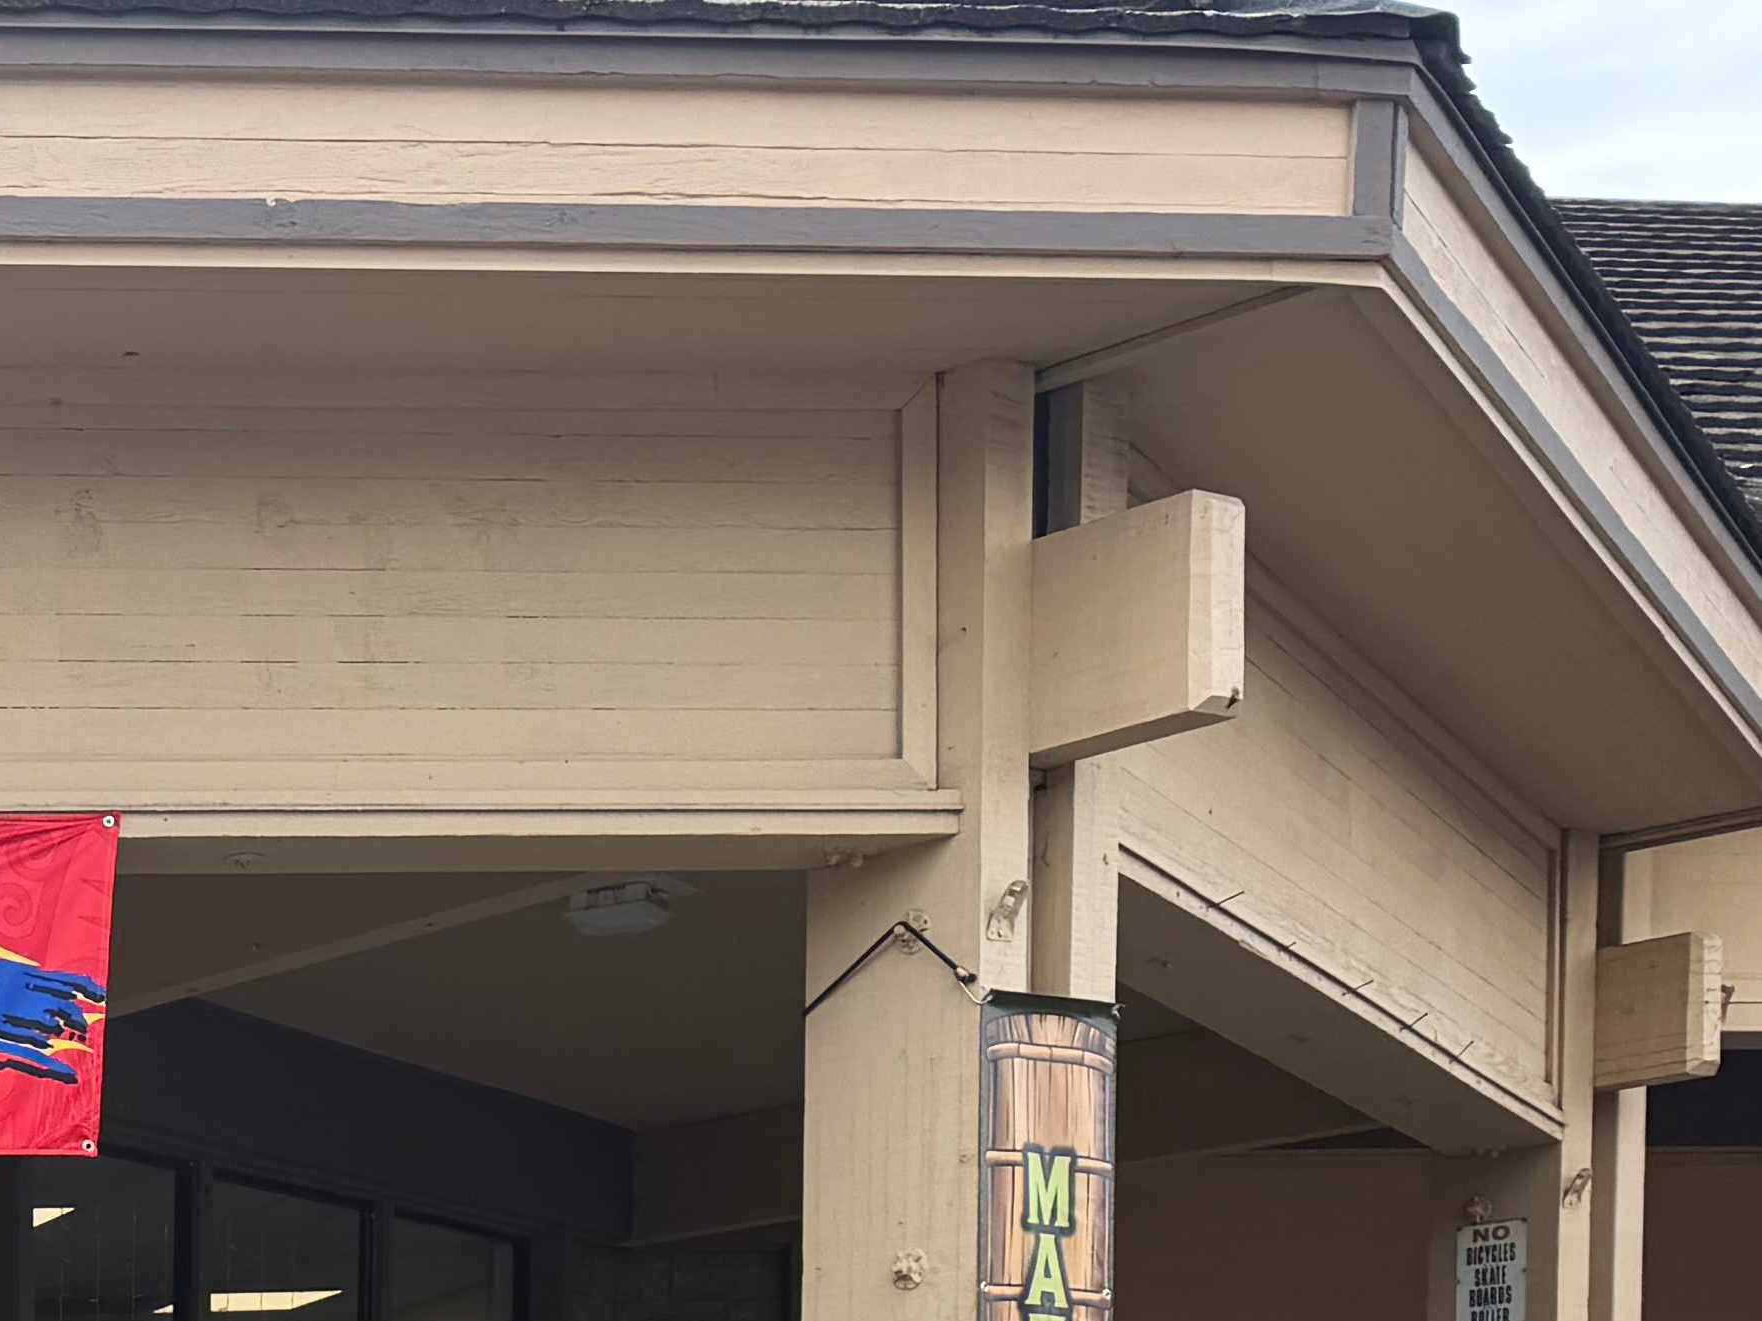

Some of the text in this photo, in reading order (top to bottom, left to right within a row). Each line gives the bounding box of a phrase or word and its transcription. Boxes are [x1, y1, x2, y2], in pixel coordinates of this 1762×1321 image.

[1472, 1225, 1511, 1243] NO
[1466, 1242, 1517, 1266] BICYCLES
[1473, 1265, 1507, 1287] SKATE
[1468, 1285, 1513, 1308] BOARDS
